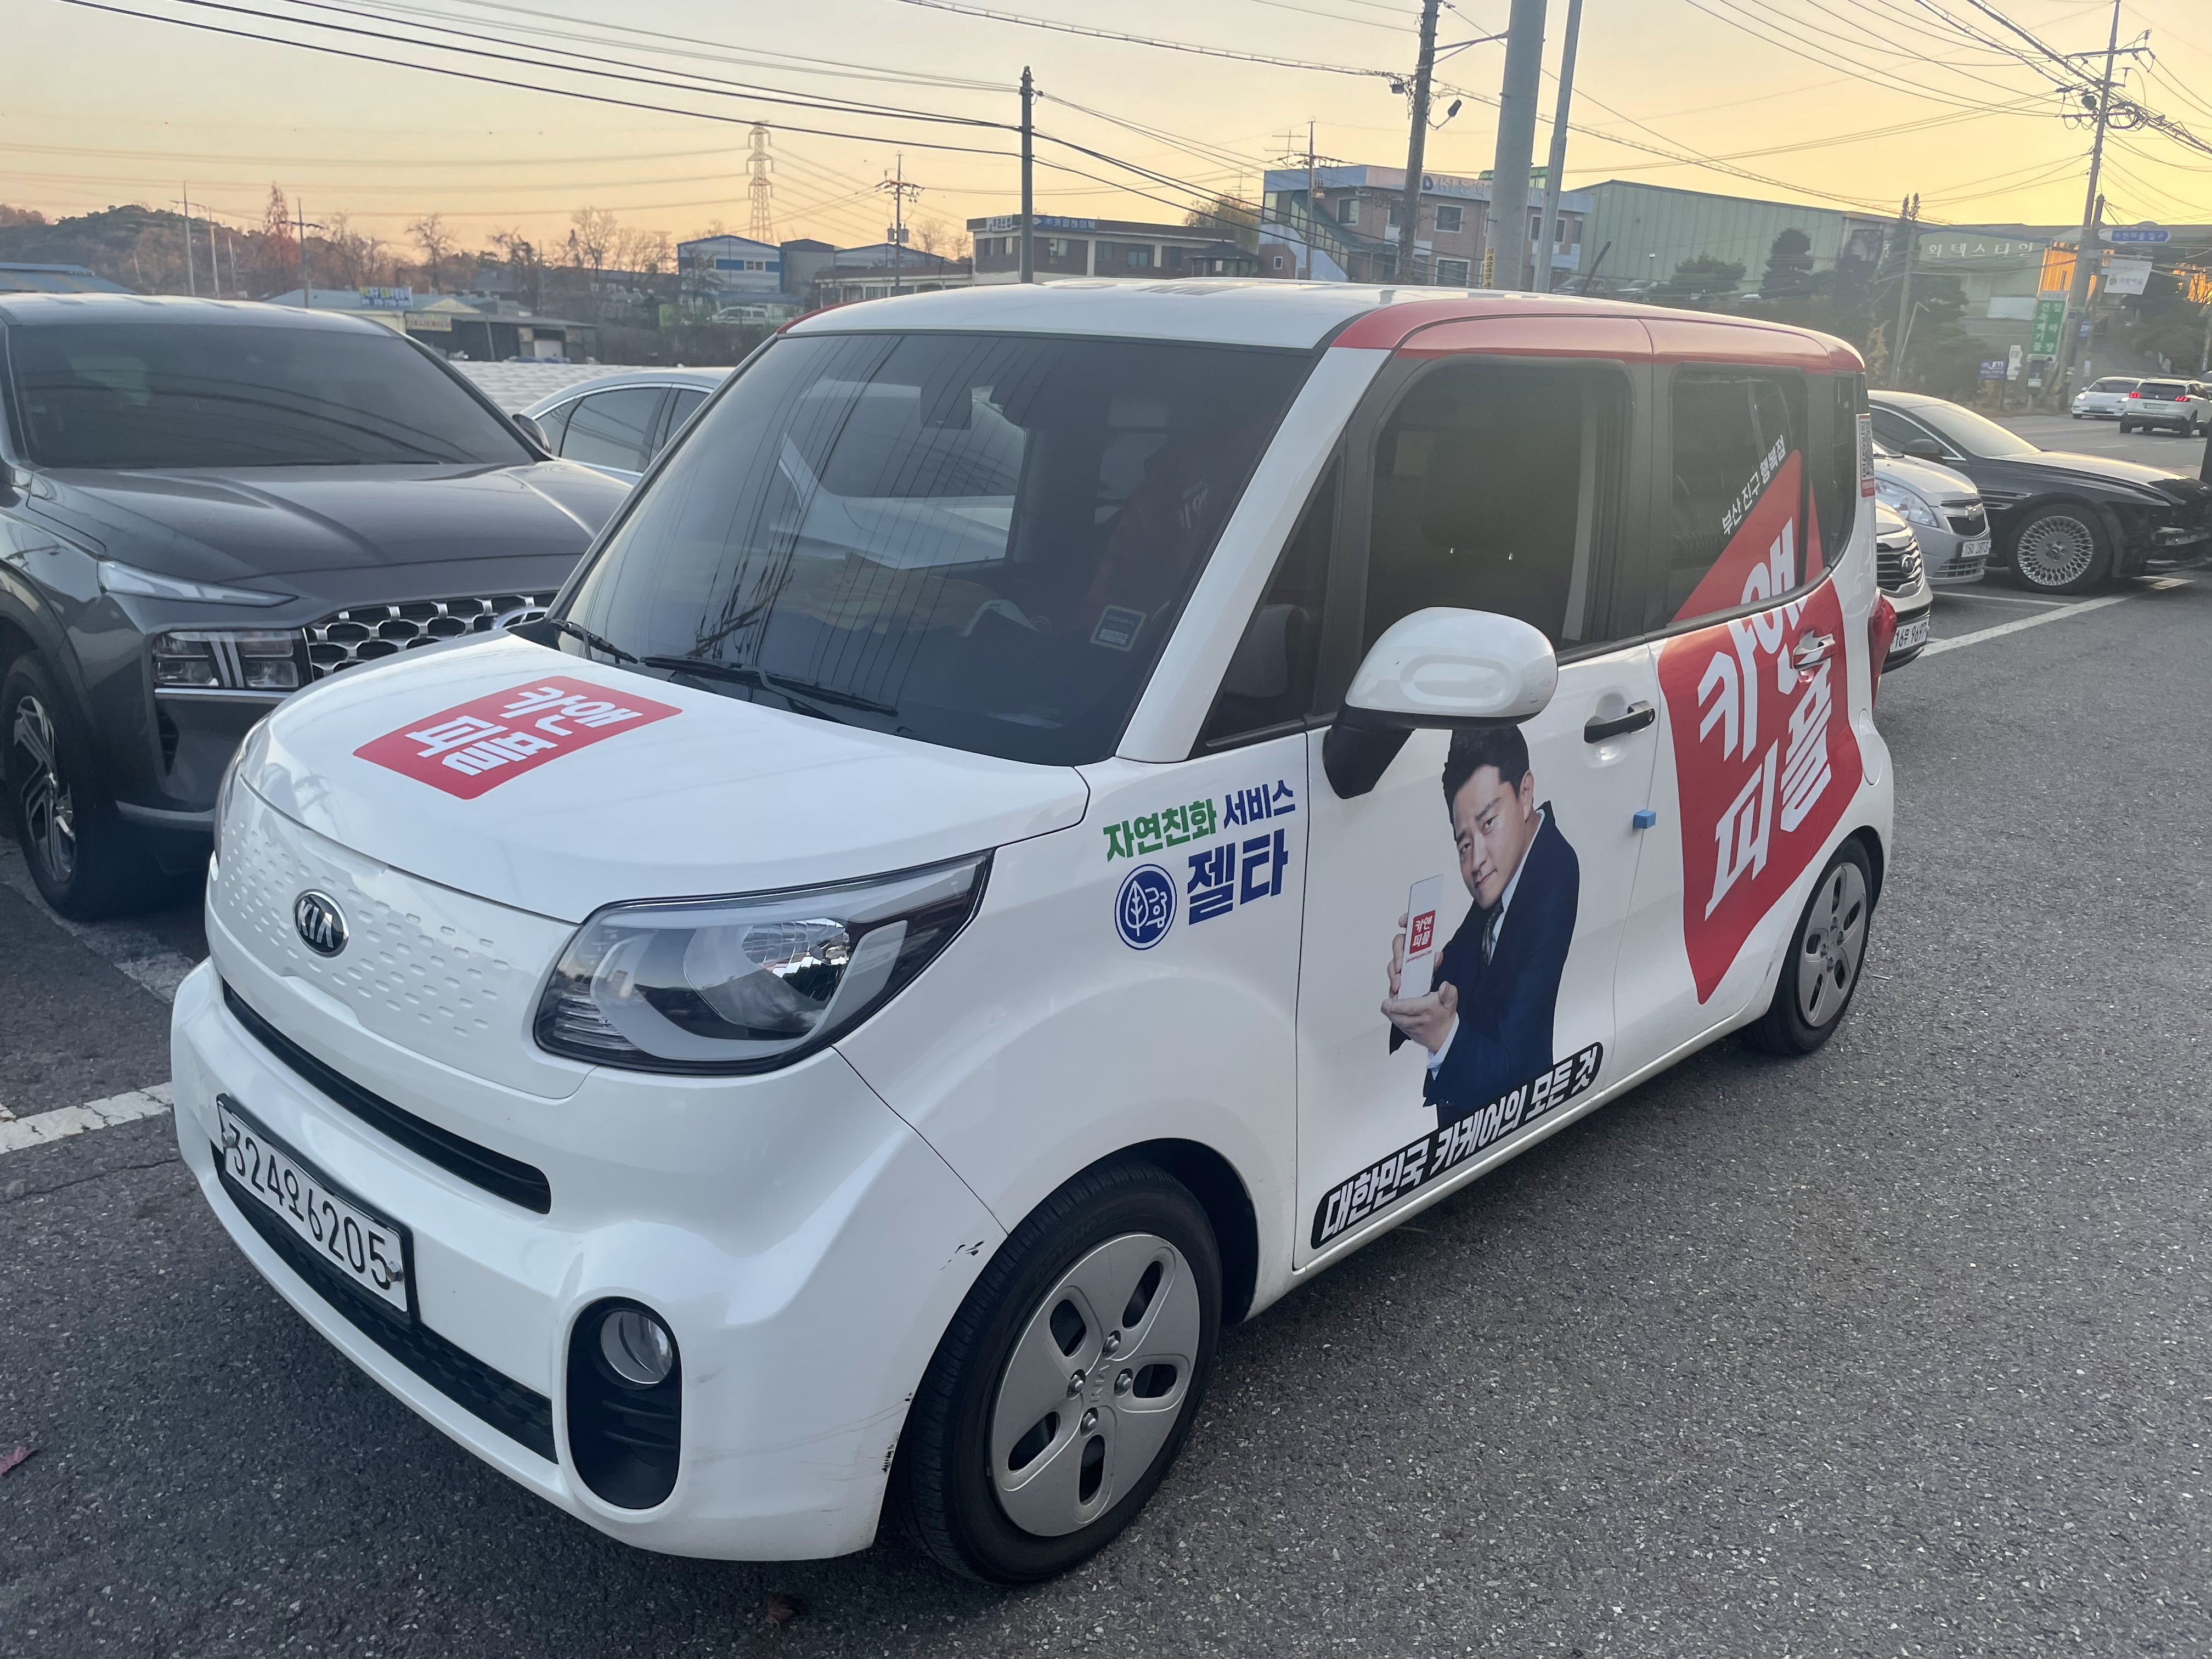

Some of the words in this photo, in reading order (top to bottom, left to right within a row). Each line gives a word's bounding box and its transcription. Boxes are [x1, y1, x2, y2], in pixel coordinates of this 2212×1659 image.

[1722, 497, 1742, 535] 부산
[1741, 471, 1760, 511] 진구
[1760, 434, 1786, 484] 행복점
[1697, 517, 1824, 763] 카앤
[404, 715, 558, 776] 피플
[499, 686, 644, 737] 카앤
[1103, 798, 1217, 862] 자연친화
[1223, 780, 1296, 829] 서비스
[1705, 658, 1831, 921] 피플
[1187, 828, 1289, 926] 젤타
[297, 898, 334, 949] KIA
[1412, 930, 1431, 947] 피플
[1319, 1138, 1431, 1242] 대한민국
[1429, 1084, 1527, 1176] 카케어의
[1524, 1059, 1573, 1122] 모든
[1571, 1045, 1598, 1095] 것
[229, 1122, 391, 1290] 324오6205
[1091, 1364, 1110, 1401] KIA
